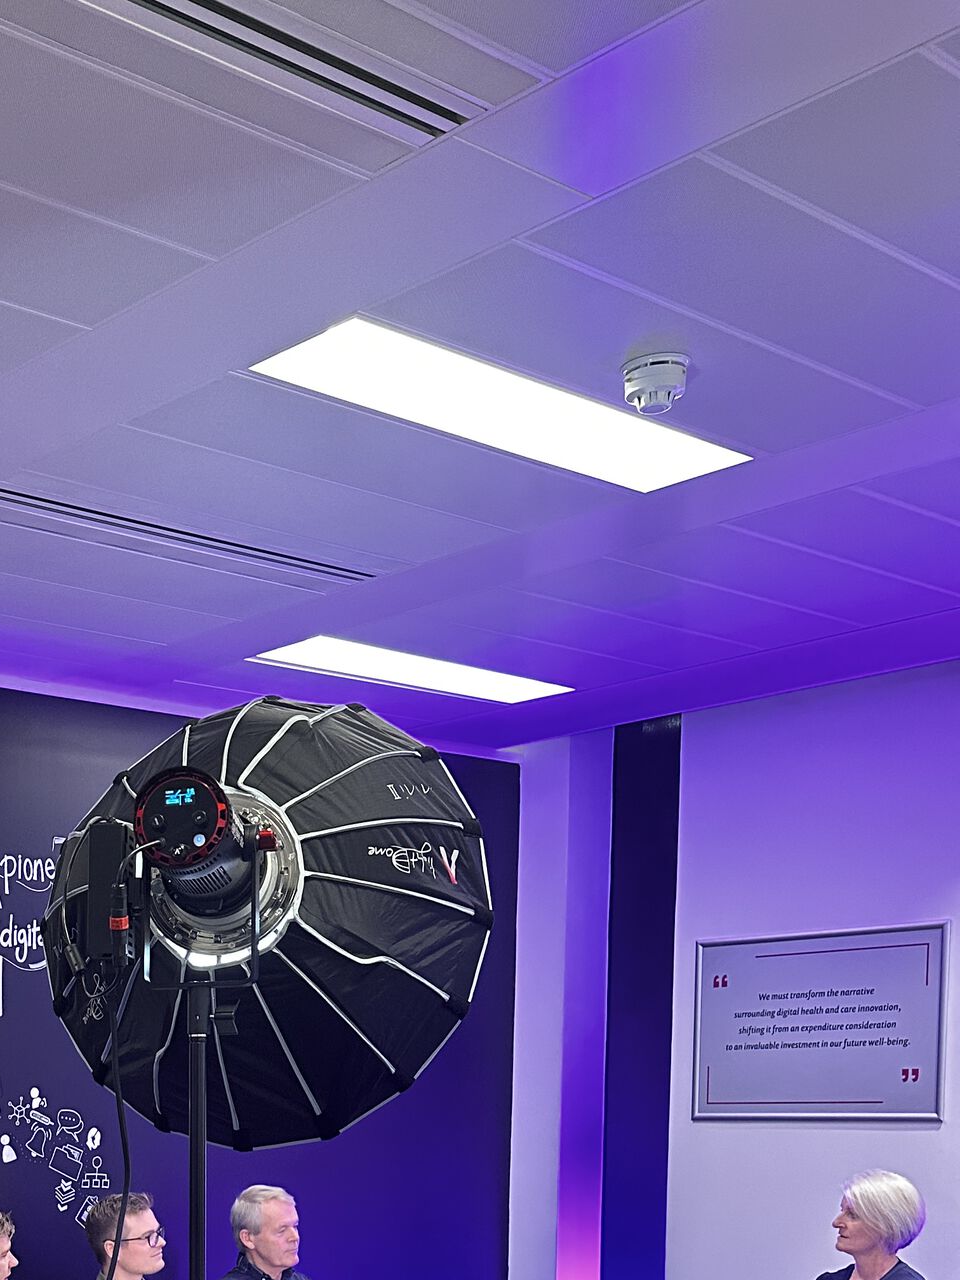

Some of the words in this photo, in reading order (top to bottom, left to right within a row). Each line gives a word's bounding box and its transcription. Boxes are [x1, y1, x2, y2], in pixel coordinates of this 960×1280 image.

[0, 854, 56, 895] pione
[771, 992, 789, 1000] must
[790, 989, 825, 1001] transform
[826, 988, 839, 997] the
[840, 986, 875, 996] narrative
[734, 1009, 776, 1019] surrounding
[776, 1007, 800, 1018] digital
[801, 1006, 824, 1015] health
[825, 1004, 840, 1014] and
[840, 1005, 857, 1013] care
[857, 1002, 902, 1012] innovation,
[738, 1025, 765, 1036] shifting
[766, 1025, 772, 1033] it
[772, 1024, 789, 1035] from
[790, 1024, 800, 1032] an
[800, 1022, 844, 1034] expenditure
[845, 1020, 897, 1031] consideration
[725, 1043, 733, 1051] to
[743, 1041, 780, 1050] invaluable
[780, 1040, 820, 1049] investment
[821, 1039, 829, 1048] in
[829, 1040, 843, 1048] our
[842, 1038, 868, 1050] future
[868, 1037, 911, 1048] well-being.
